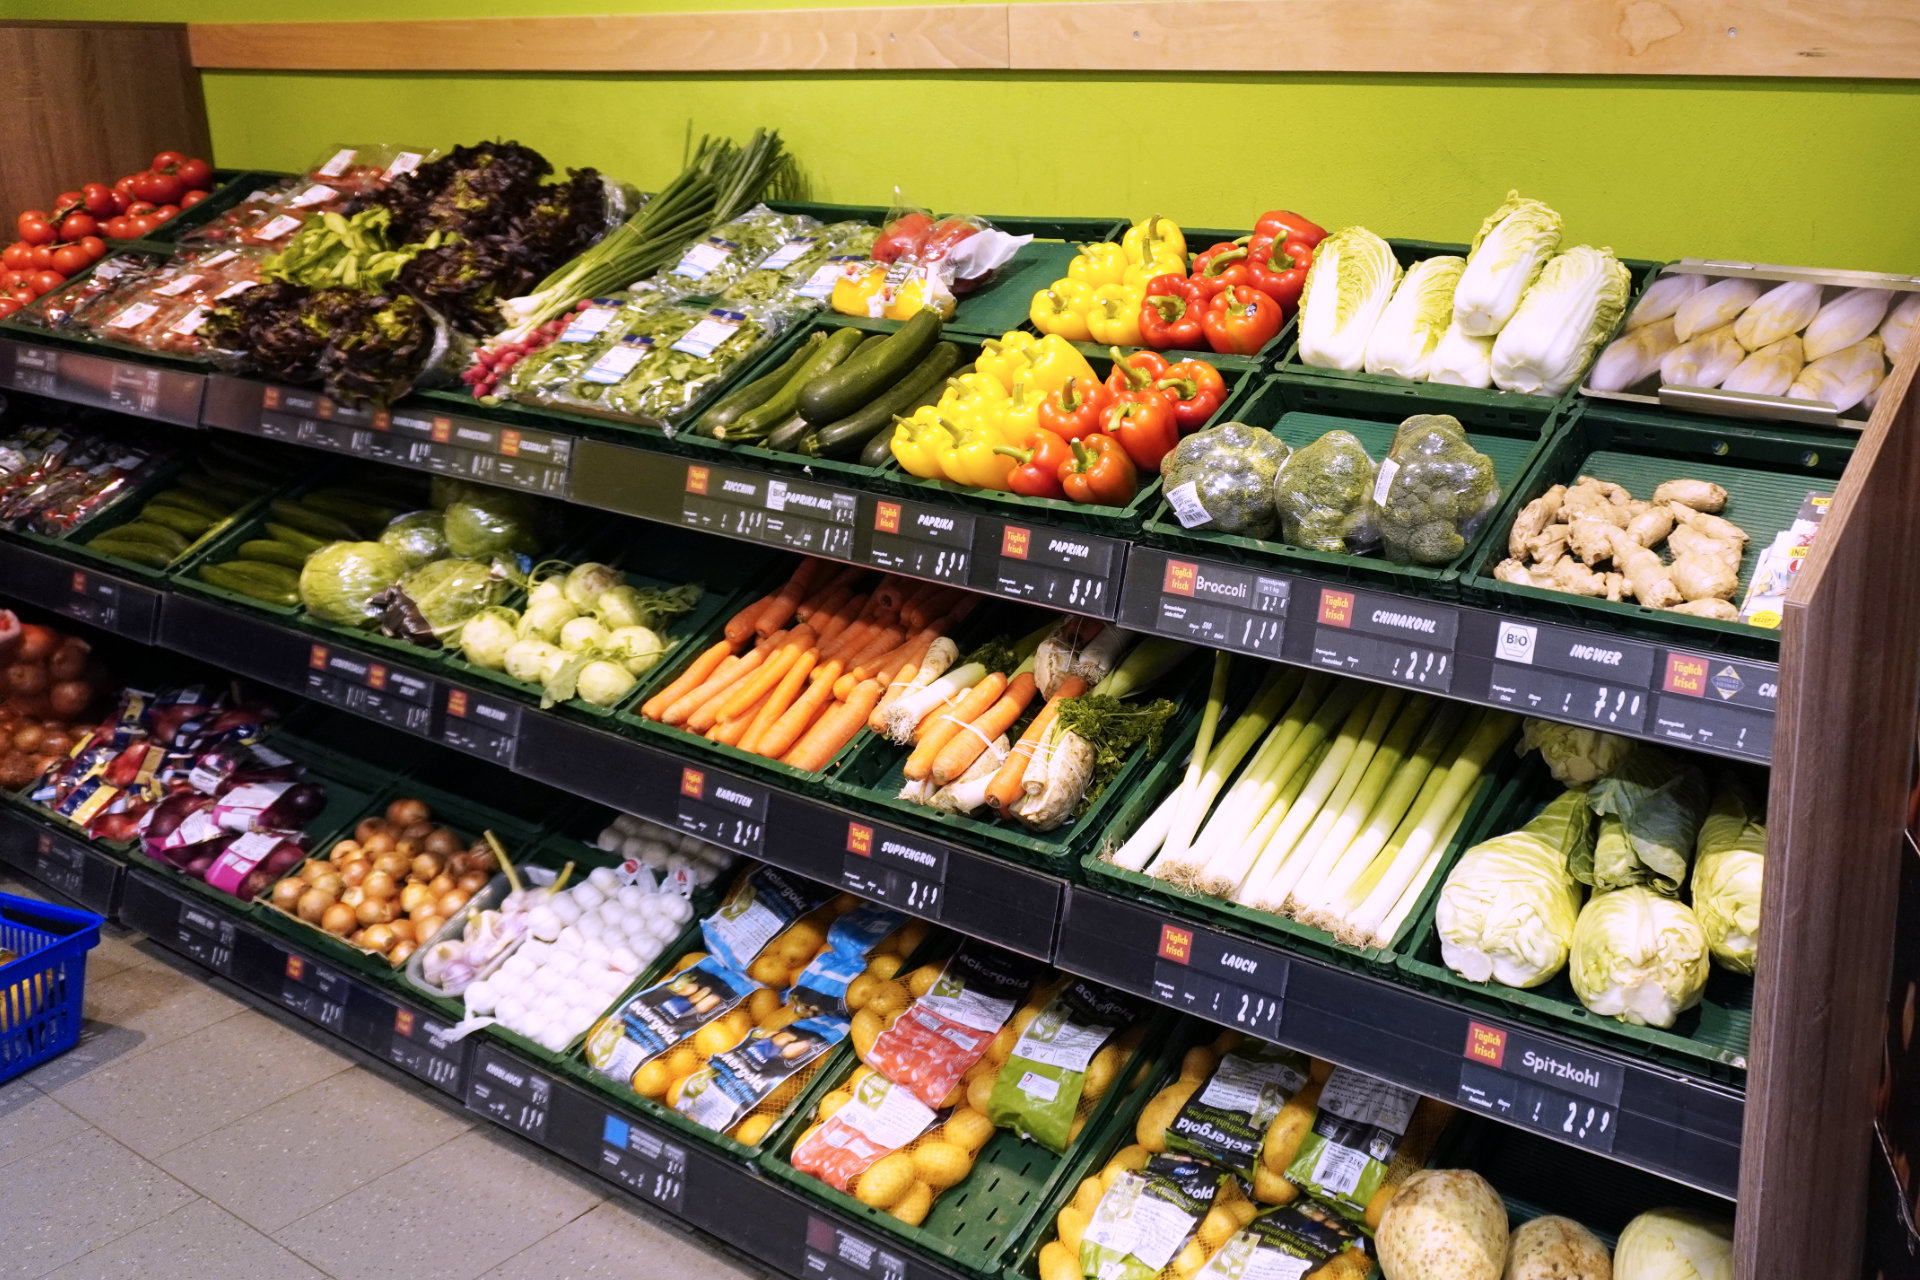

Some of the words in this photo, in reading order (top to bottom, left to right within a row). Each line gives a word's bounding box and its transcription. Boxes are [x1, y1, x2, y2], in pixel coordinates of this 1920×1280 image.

[917, 514, 954, 531] PAPRIKA
[1007, 531, 1027, 543] Täglich
[1007, 543, 1023, 555] frisch
[1048, 539, 1090, 558] PAPRIKA
[1171, 565, 1193, 579] Täglich
[1171, 579, 1189, 591] frisch
[1196, 576, 1247, 598] Broccoli
[1325, 594, 1349, 609] Täglich
[1325, 608, 1345, 621] frisch
[1371, 610, 1437, 634] CHINAKOHL
[1569, 643, 1623, 666] INGWER
[1673, 660, 1703, 677] Täglich
[1673, 675, 1698, 691] frisch
[715, 786, 753, 808] KAROTTEN
[1166, 930, 1189, 945] Täglich
[1166, 943, 1184, 958] frisch
[1220, 952, 1258, 974] LAUCH
[1473, 1027, 1501, 1047] Täglich
[1474, 1044, 1497, 1060] frisch
[1522, 1051, 1600, 1088] Spitzkohl
[1176, 1117, 1254, 1153] ackergold
